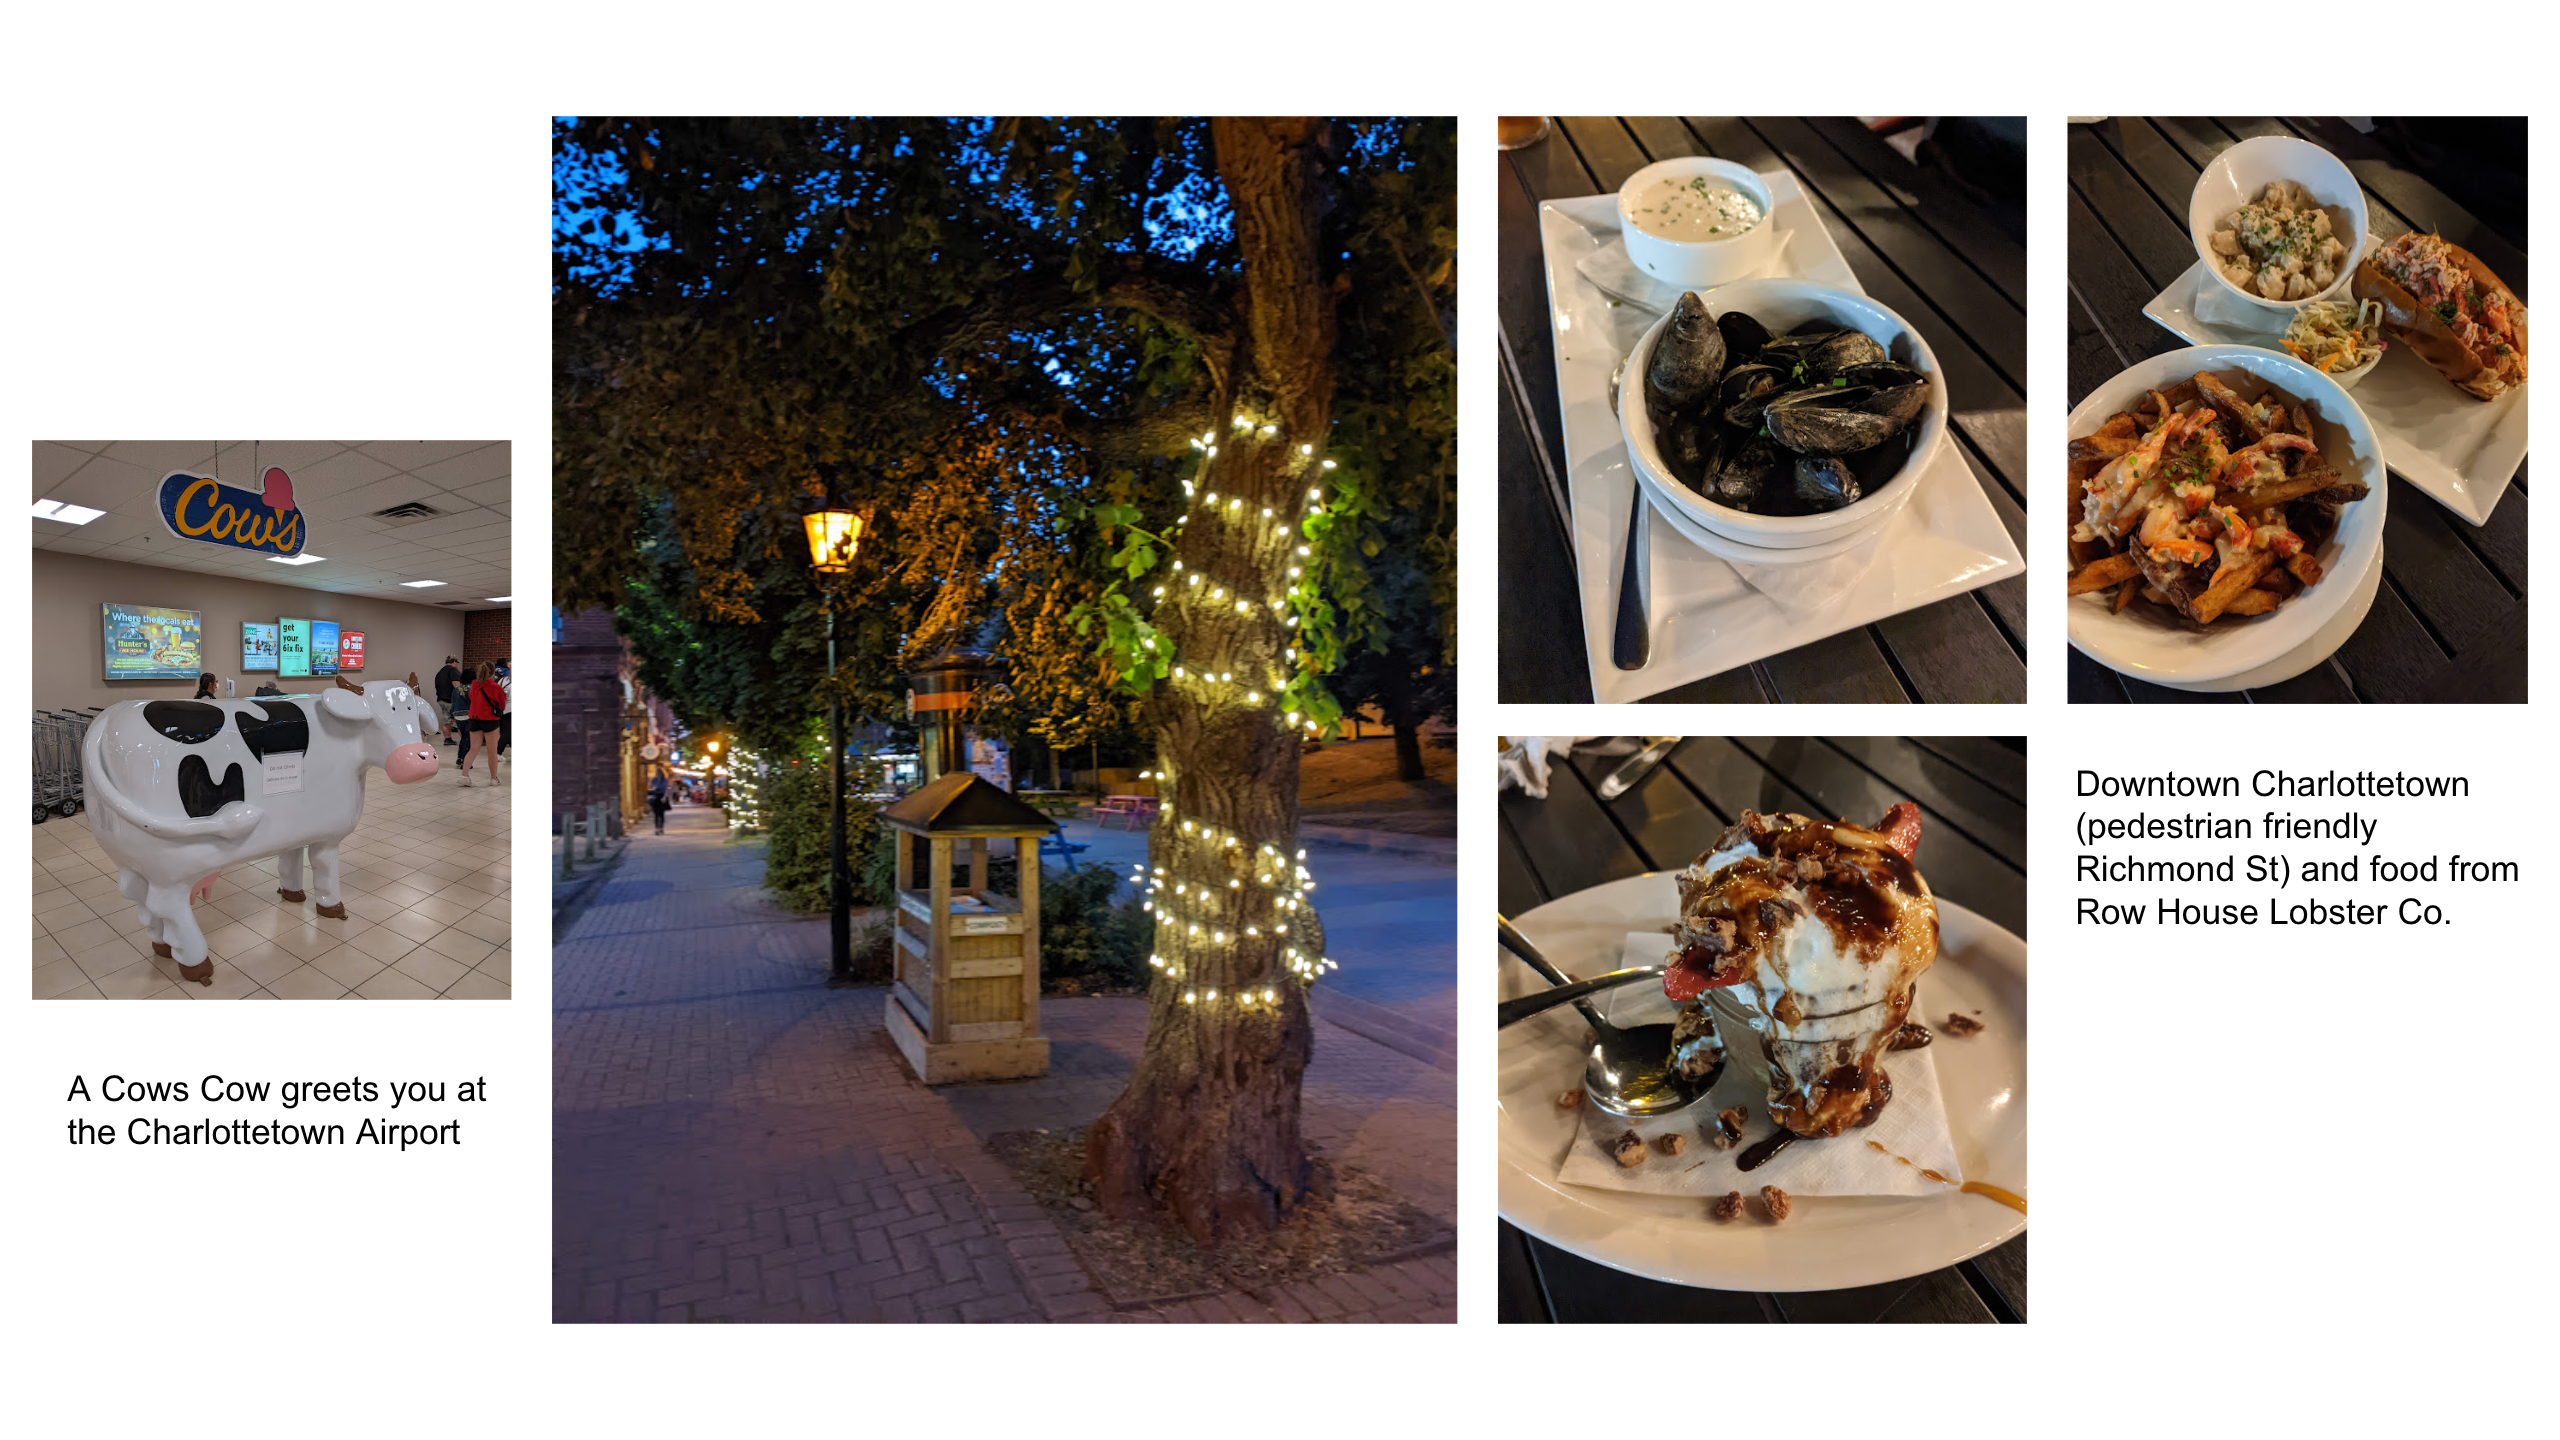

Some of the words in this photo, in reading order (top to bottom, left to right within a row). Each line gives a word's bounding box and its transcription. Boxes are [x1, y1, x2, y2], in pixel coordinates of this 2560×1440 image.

[112, 612, 141, 622] Where
[143, 615, 157, 623] the
[157, 616, 180, 625] locals
[283, 623, 294, 633] get
[283, 635, 298, 643] your
[118, 640, 148, 648] Hunter's
[282, 644, 293, 652] 6ix
[295, 644, 304, 652] fix
